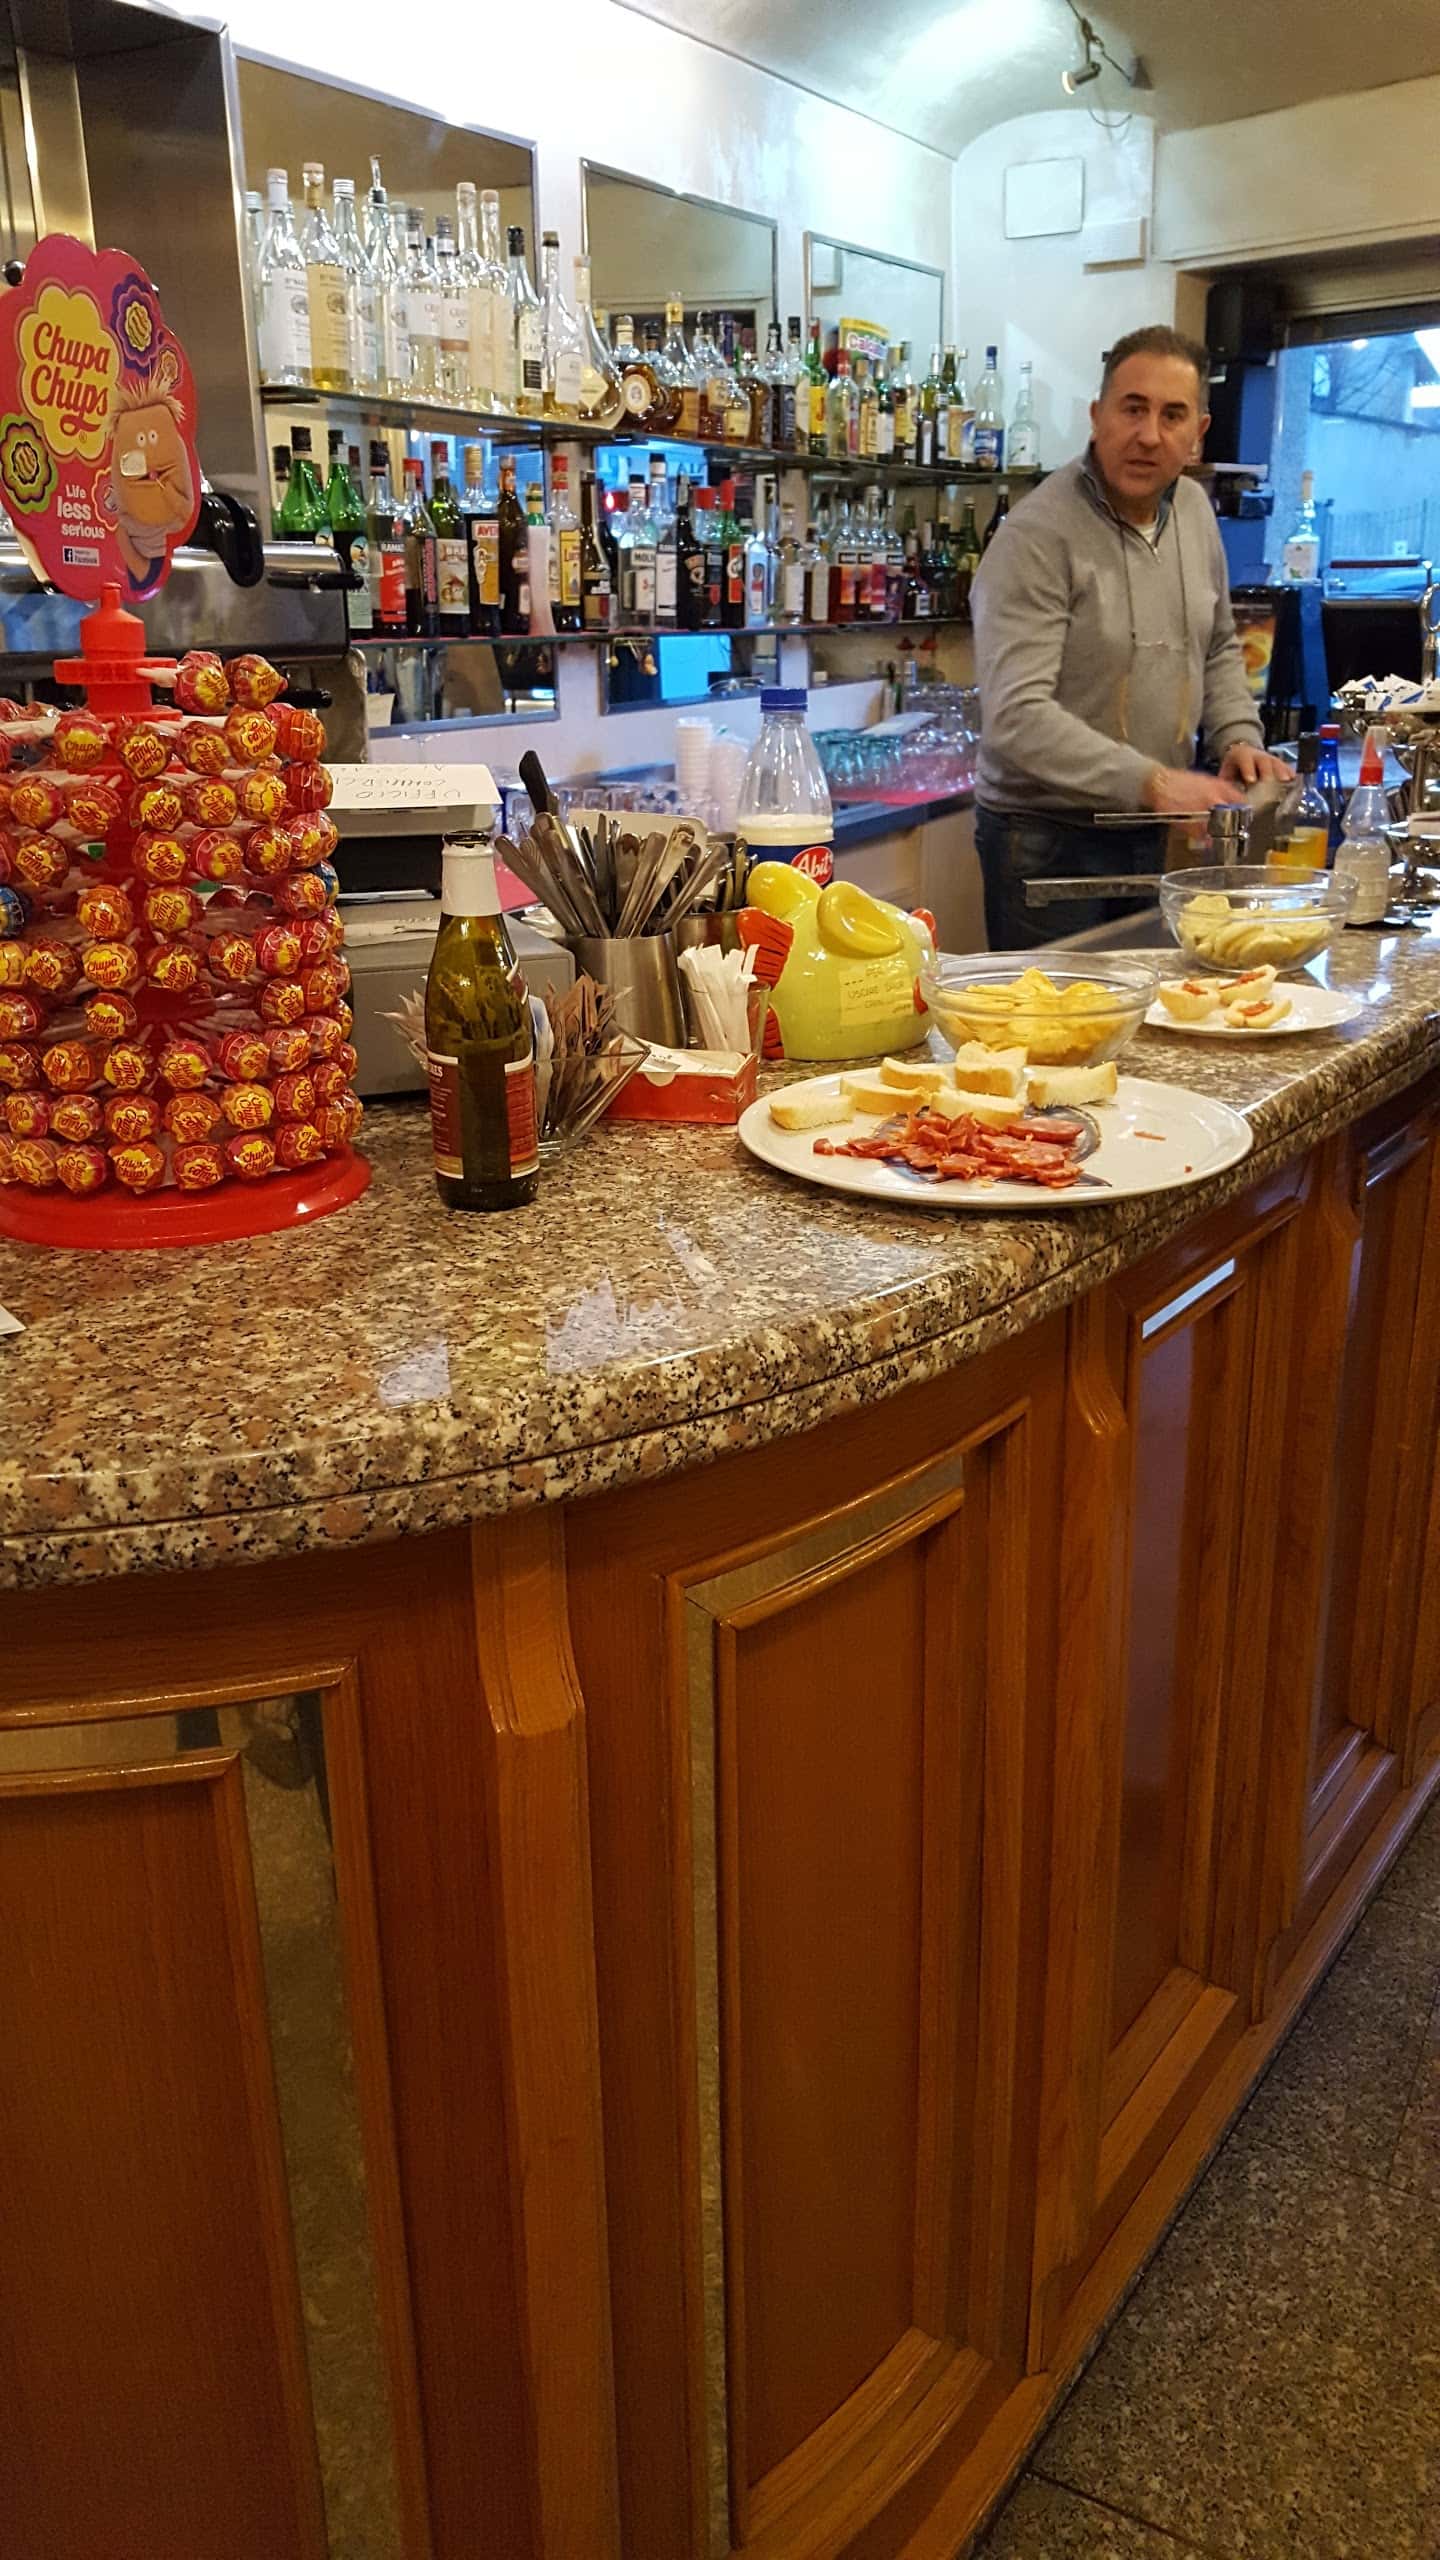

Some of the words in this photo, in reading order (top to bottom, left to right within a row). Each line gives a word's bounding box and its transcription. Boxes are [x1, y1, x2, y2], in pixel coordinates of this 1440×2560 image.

[33, 321, 111, 379] Chupa
[31, 363, 109, 436] Chups
[65, 484, 87, 499] Life
[57, 496, 91, 520] less
[61, 521, 105, 538] serious
